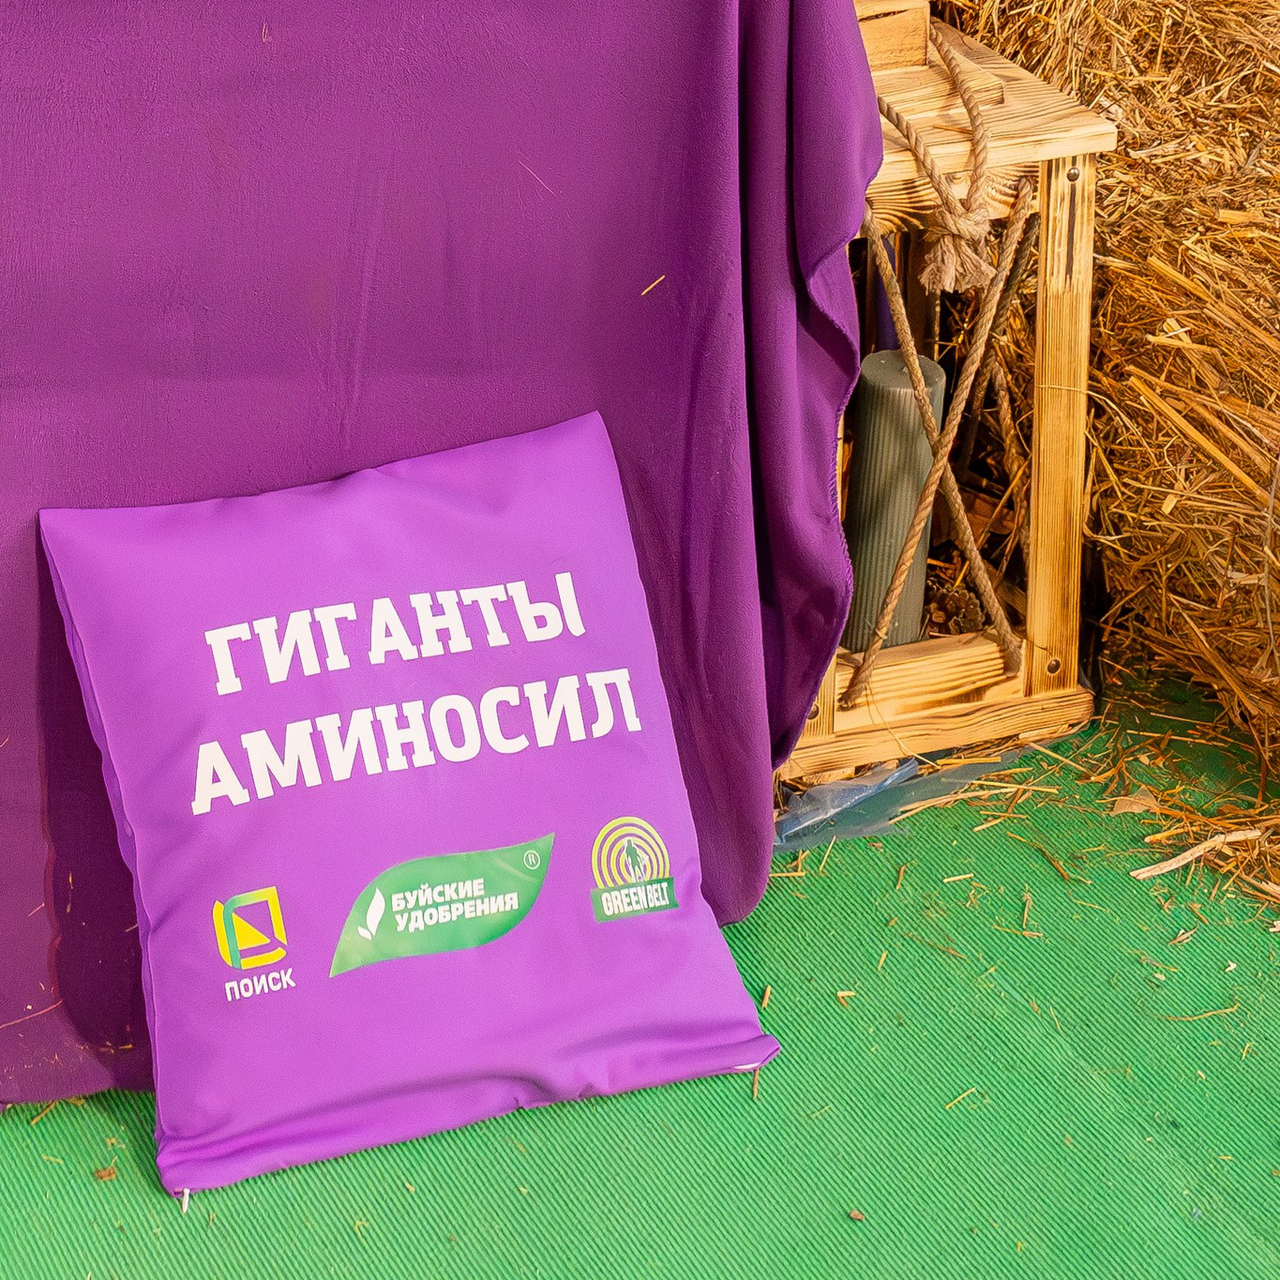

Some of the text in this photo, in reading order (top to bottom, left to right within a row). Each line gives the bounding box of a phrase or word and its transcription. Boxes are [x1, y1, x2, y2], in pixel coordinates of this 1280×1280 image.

[204, 571, 587, 696] ГИГАНТЫ
[190, 668, 642, 816] АМИНОСИЛ
[391, 878, 485, 912] БУЙСКИЕ
[394, 891, 519, 933] УДОБРЕНИЯ
[224, 968, 297, 1002] ПОИСК
